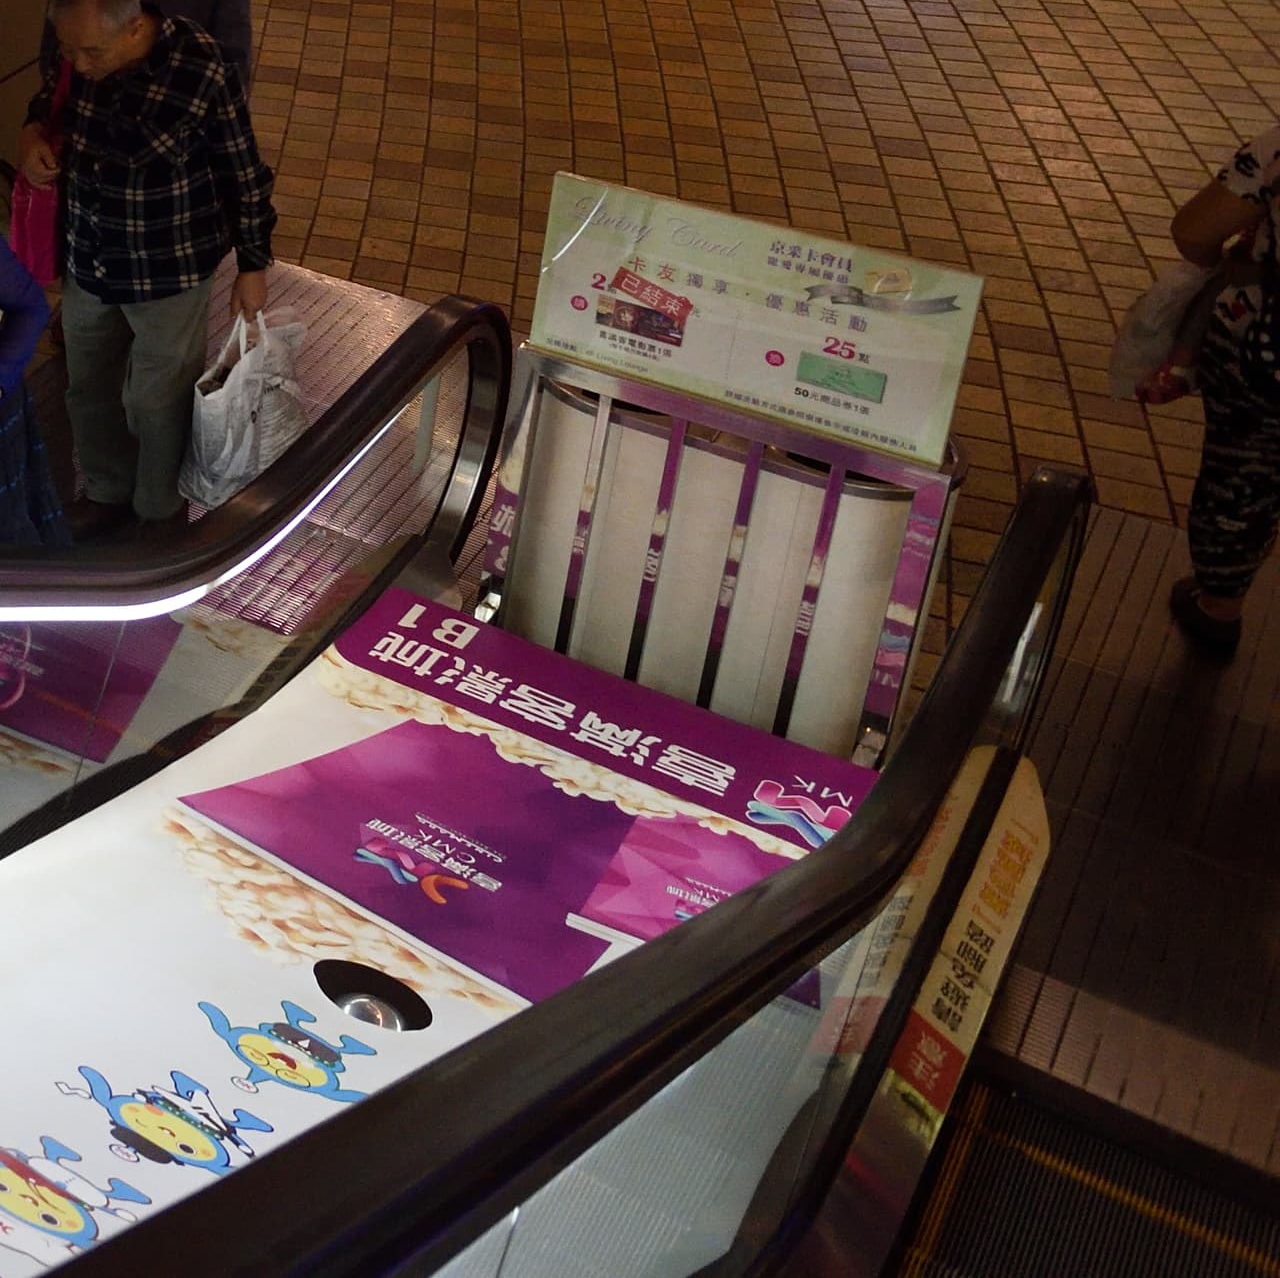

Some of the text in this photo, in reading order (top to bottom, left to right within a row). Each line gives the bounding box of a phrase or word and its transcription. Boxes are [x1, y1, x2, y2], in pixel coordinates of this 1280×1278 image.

[620, 273, 685, 318] 已結束
[393, 603, 479, 649] B1
[368, 630, 737, 798] 喜滿客影城
[907, 1030, 948, 1091] 注意
